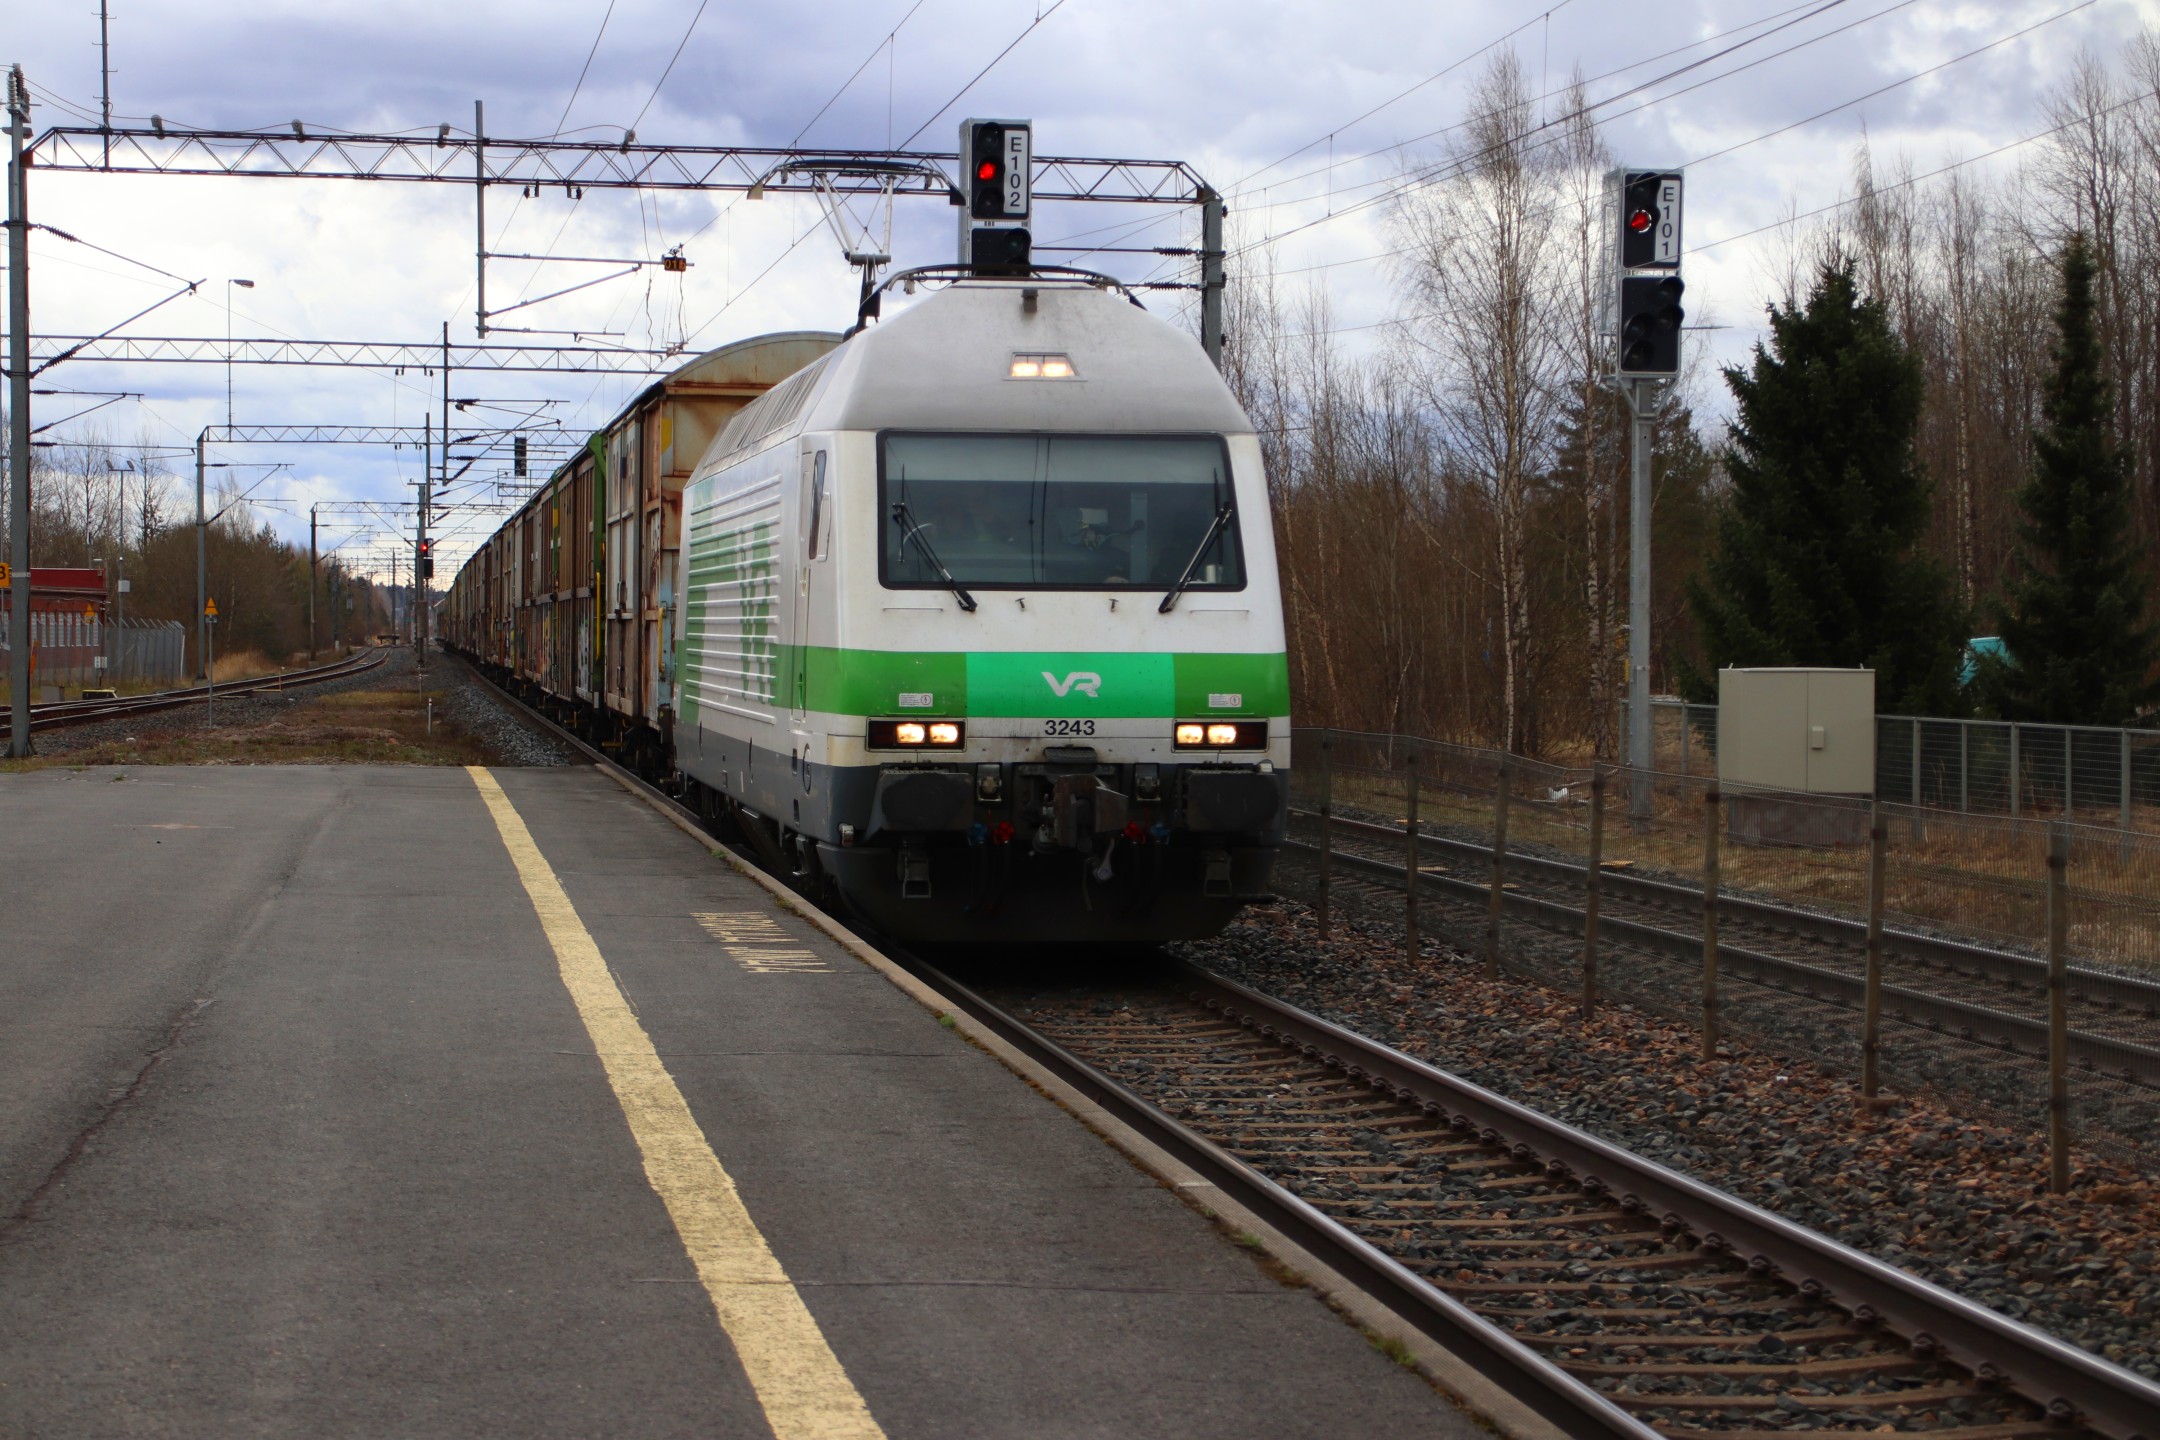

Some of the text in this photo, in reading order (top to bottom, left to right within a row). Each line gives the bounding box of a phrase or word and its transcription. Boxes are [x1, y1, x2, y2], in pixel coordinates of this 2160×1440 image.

[1010, 137, 1022, 207] E102
[1661, 187, 1675, 256] E101
[1041, 671, 1102, 698] VR
[1044, 719, 1095, 736] 3243
